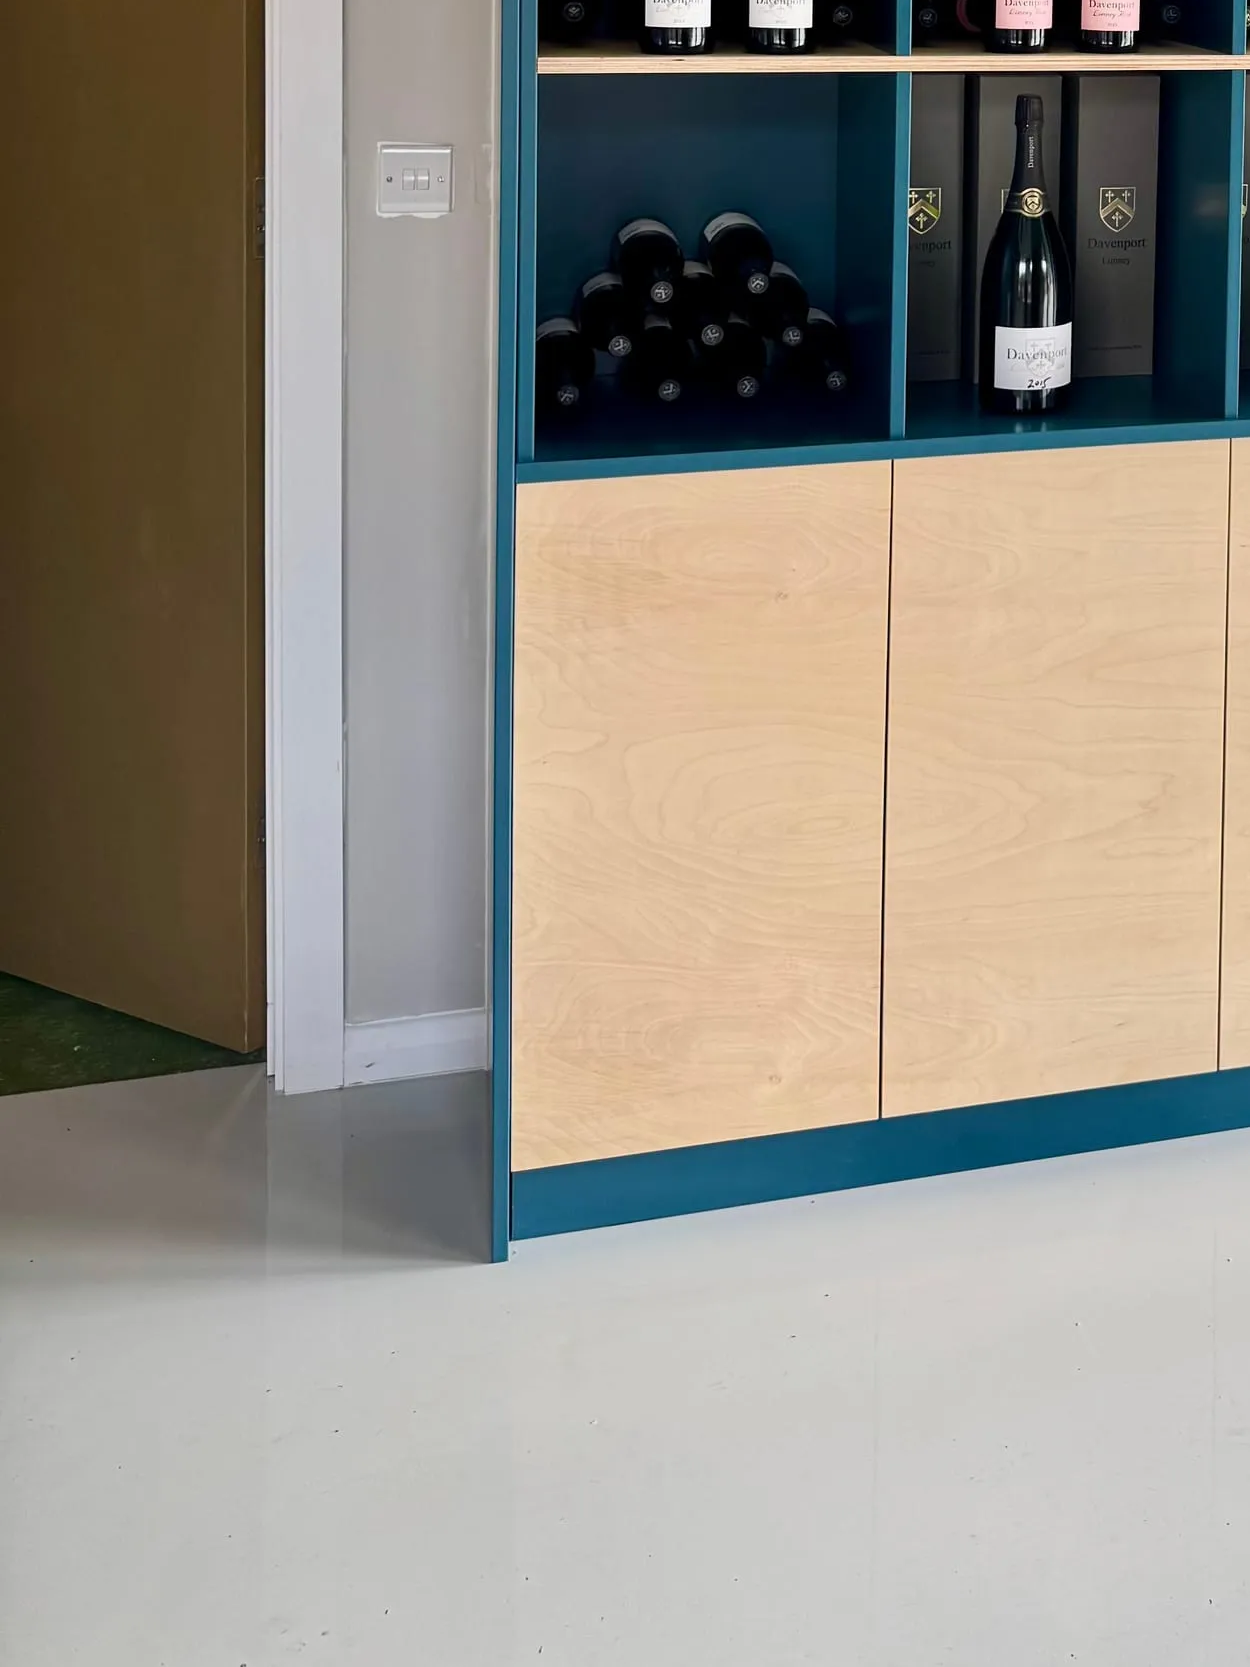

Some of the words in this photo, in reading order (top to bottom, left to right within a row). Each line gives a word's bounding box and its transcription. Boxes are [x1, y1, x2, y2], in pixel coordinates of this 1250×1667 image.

[1027, 136, 1035, 168] Davenport
[1087, 237, 1148, 251] Davenport
[1007, 347, 1067, 362] Davenport
[1027, 376, 1052, 389] 2015
